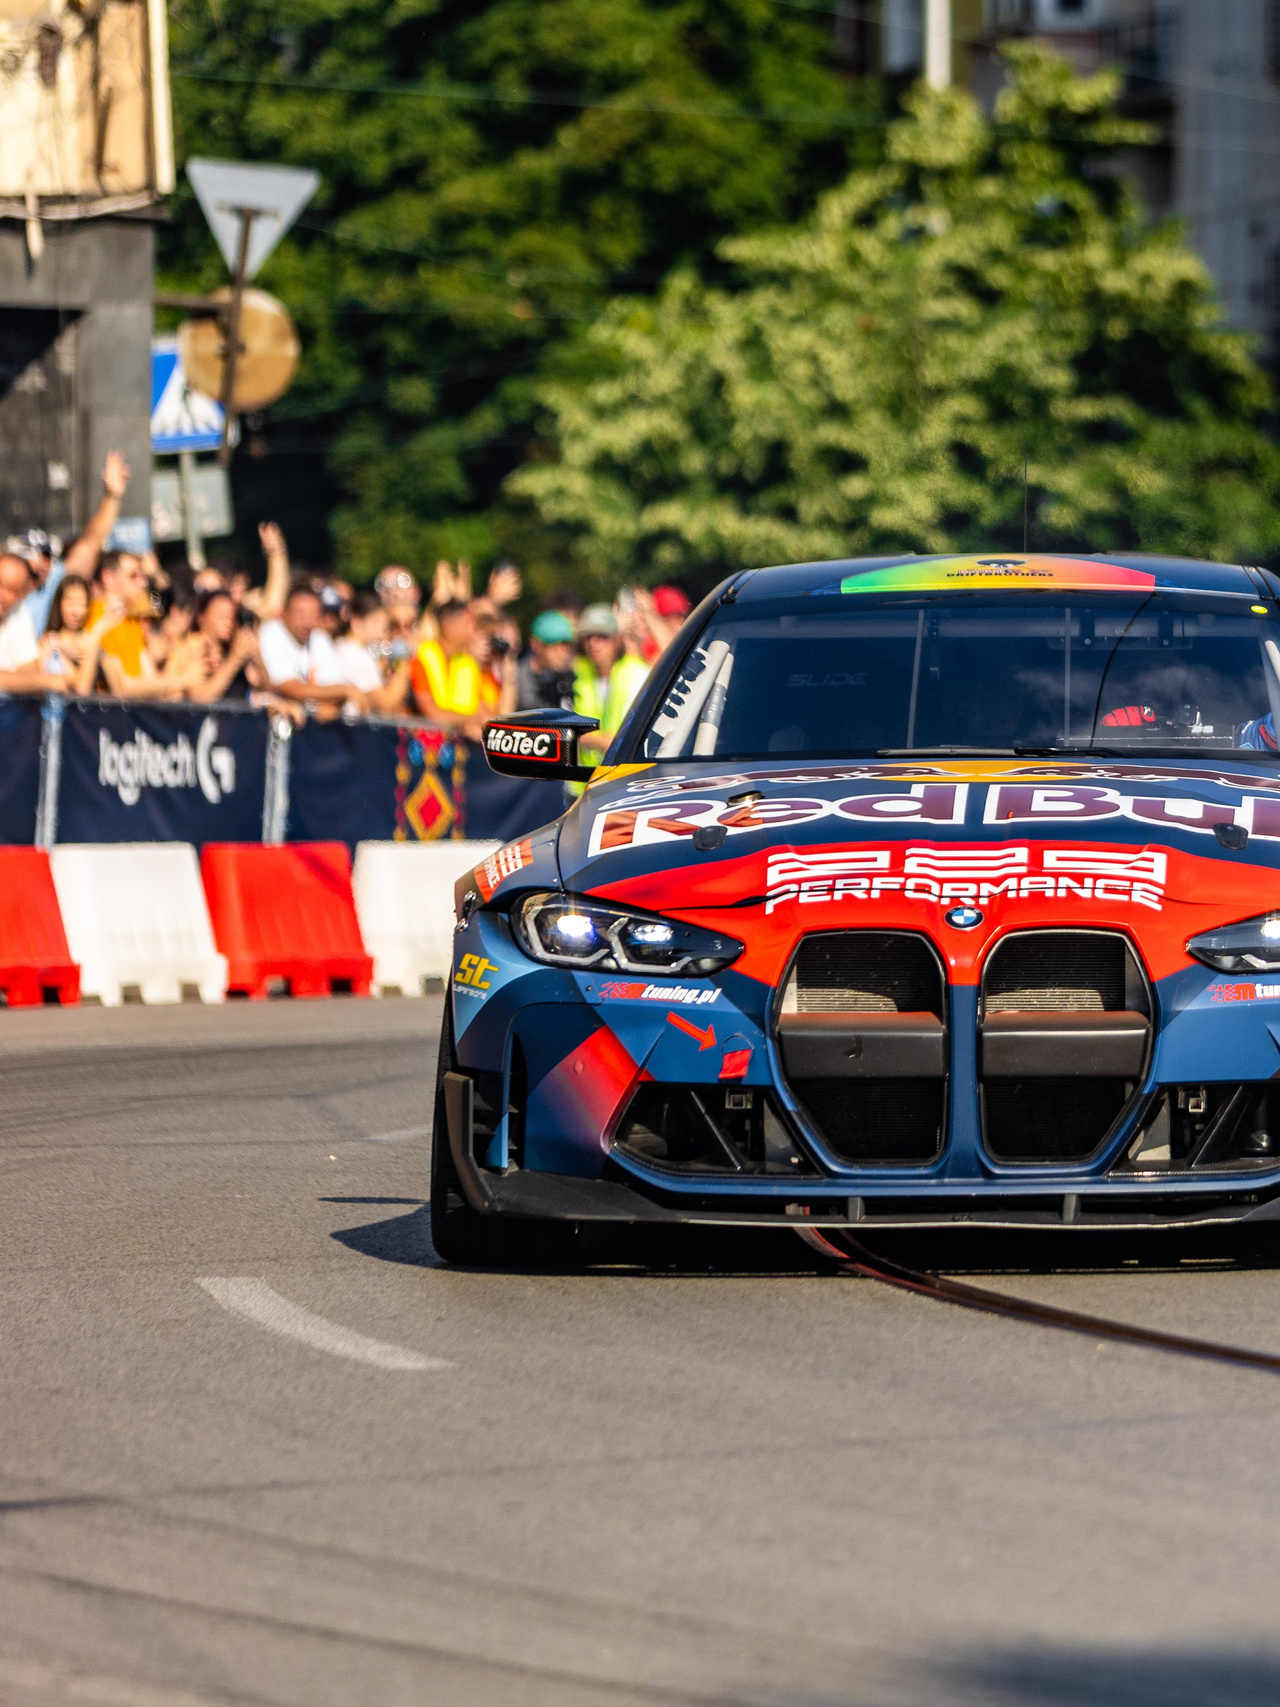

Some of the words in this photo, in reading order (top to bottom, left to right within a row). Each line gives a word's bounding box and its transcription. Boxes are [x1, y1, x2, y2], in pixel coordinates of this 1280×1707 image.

[487, 728, 551, 757] MoTeC
[587, 783, 969, 858] Red
[765, 876, 1164, 915] PERFORMANCE
